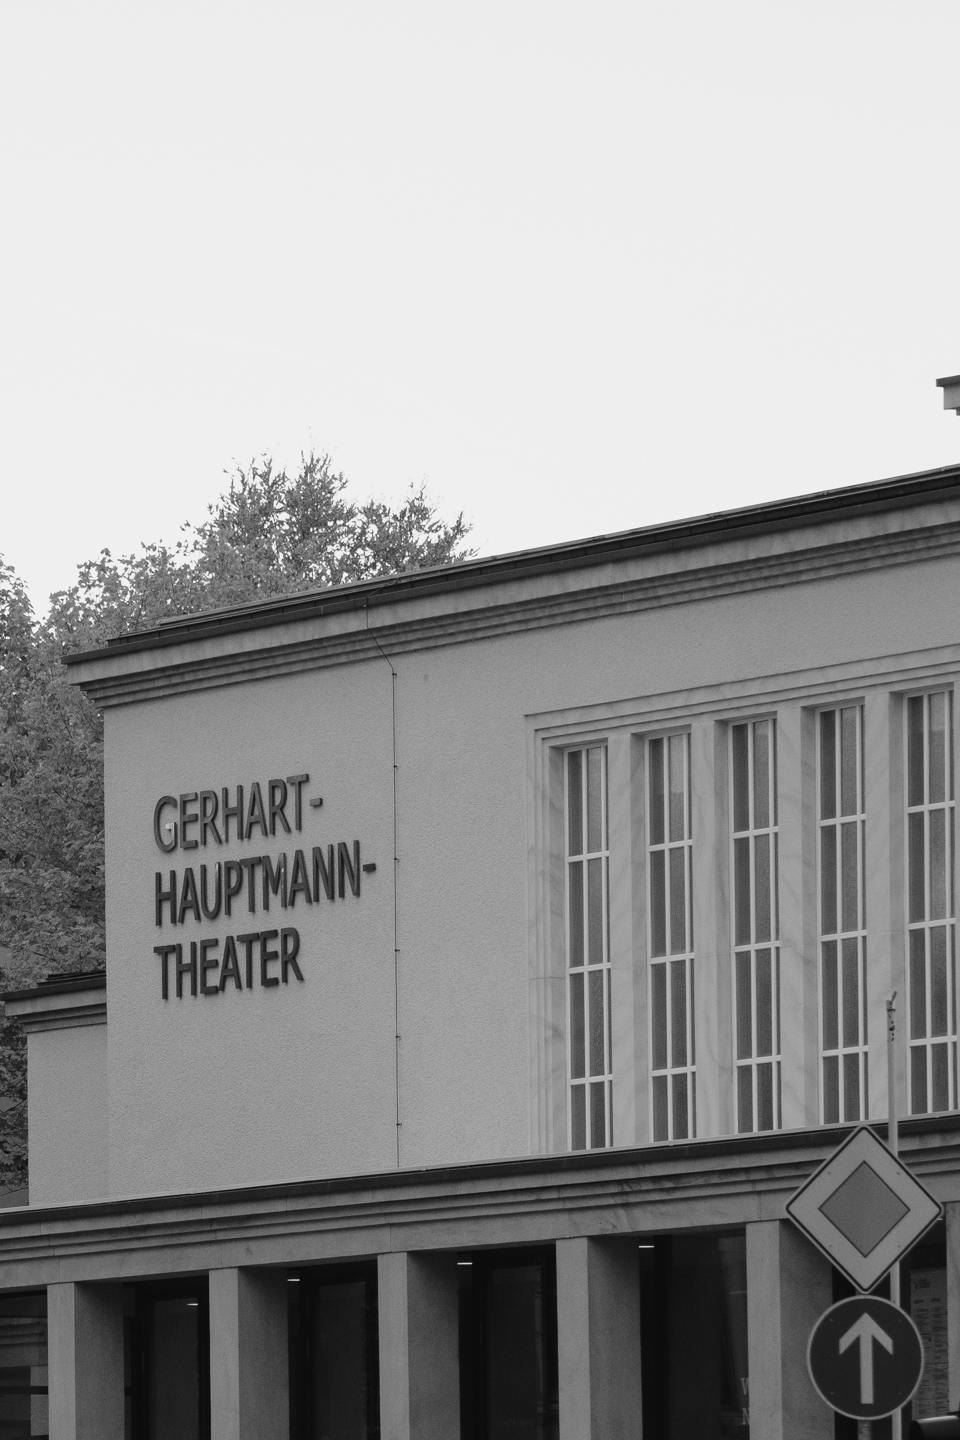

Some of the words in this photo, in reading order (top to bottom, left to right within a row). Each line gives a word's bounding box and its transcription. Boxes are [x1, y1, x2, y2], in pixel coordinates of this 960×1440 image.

[153, 774, 323, 853] GERHART-
[155, 840, 377, 927] HAUPTMANN-
[153, 927, 304, 1000] THEATER
